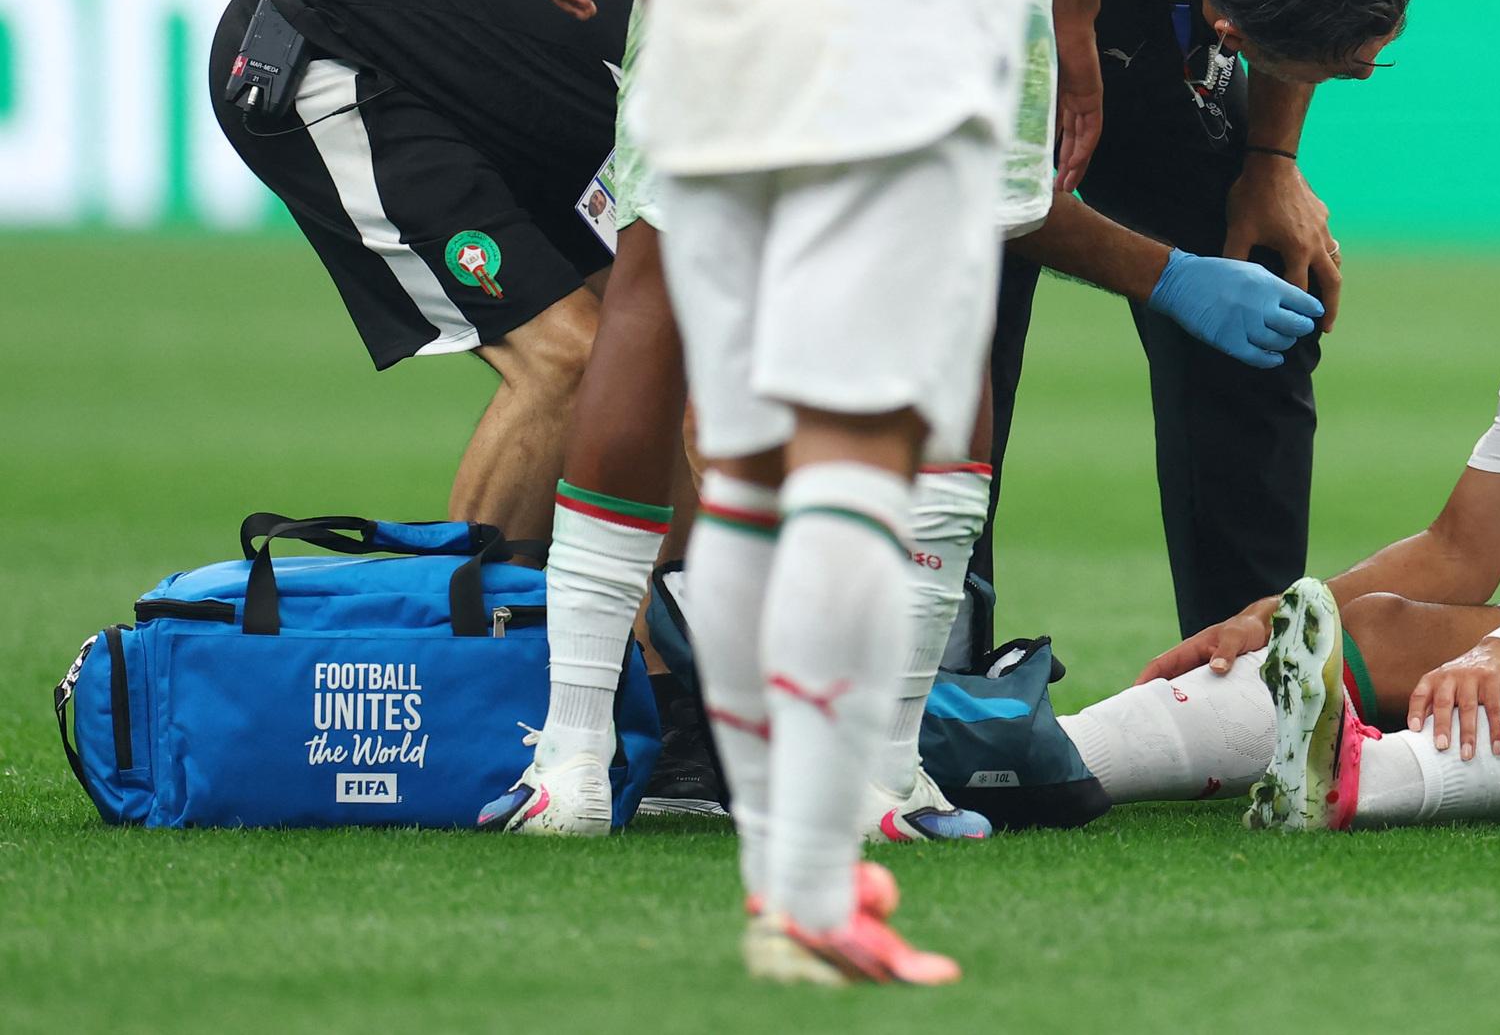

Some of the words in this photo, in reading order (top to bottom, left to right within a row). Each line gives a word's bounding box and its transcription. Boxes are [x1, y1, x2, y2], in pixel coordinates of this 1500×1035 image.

[314, 662, 422, 690] FOOTBALL
[313, 692, 422, 731] UNITES
[304, 731, 349, 766] the
[352, 731, 429, 769] World
[344, 780, 389, 795] FIFA
[994, 773, 1010, 783] 10L
